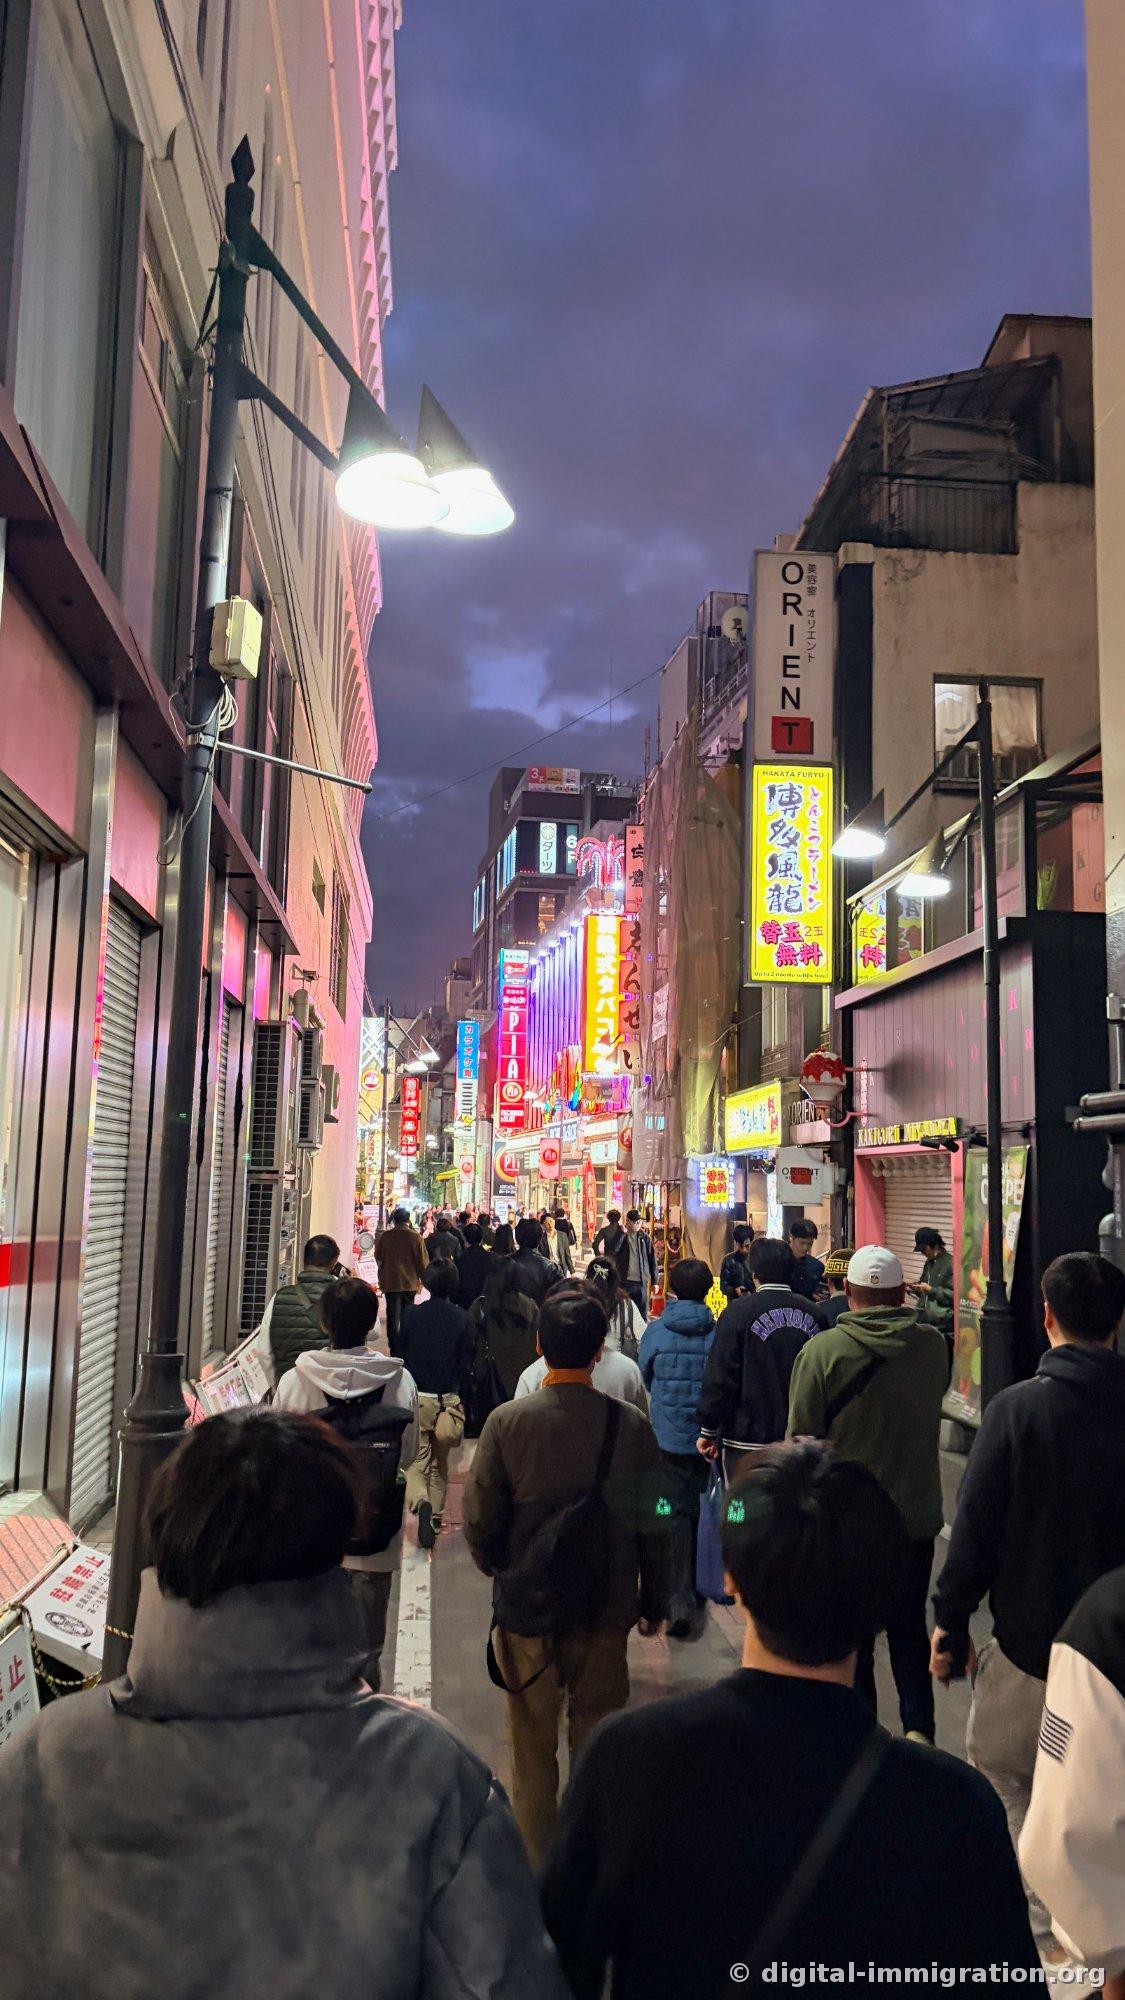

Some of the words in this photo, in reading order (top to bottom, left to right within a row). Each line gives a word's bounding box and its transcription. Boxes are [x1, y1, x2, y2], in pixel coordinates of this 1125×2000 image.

[781, 561, 804, 746] ORIENT
[806, 608, 817, 662] オリエント
[767, 782, 803, 914] 博多風龍
[808, 787, 821, 911] とんこつラーメン
[760, 920, 804, 944] 替玉
[804, 925, 823, 937] 2玉
[776, 943, 822, 967] 無料
[508, 1011, 519, 1079] PIA
[791, 1099, 815, 1124] ORIEN
[782, 1167, 820, 1176] ORIENT
